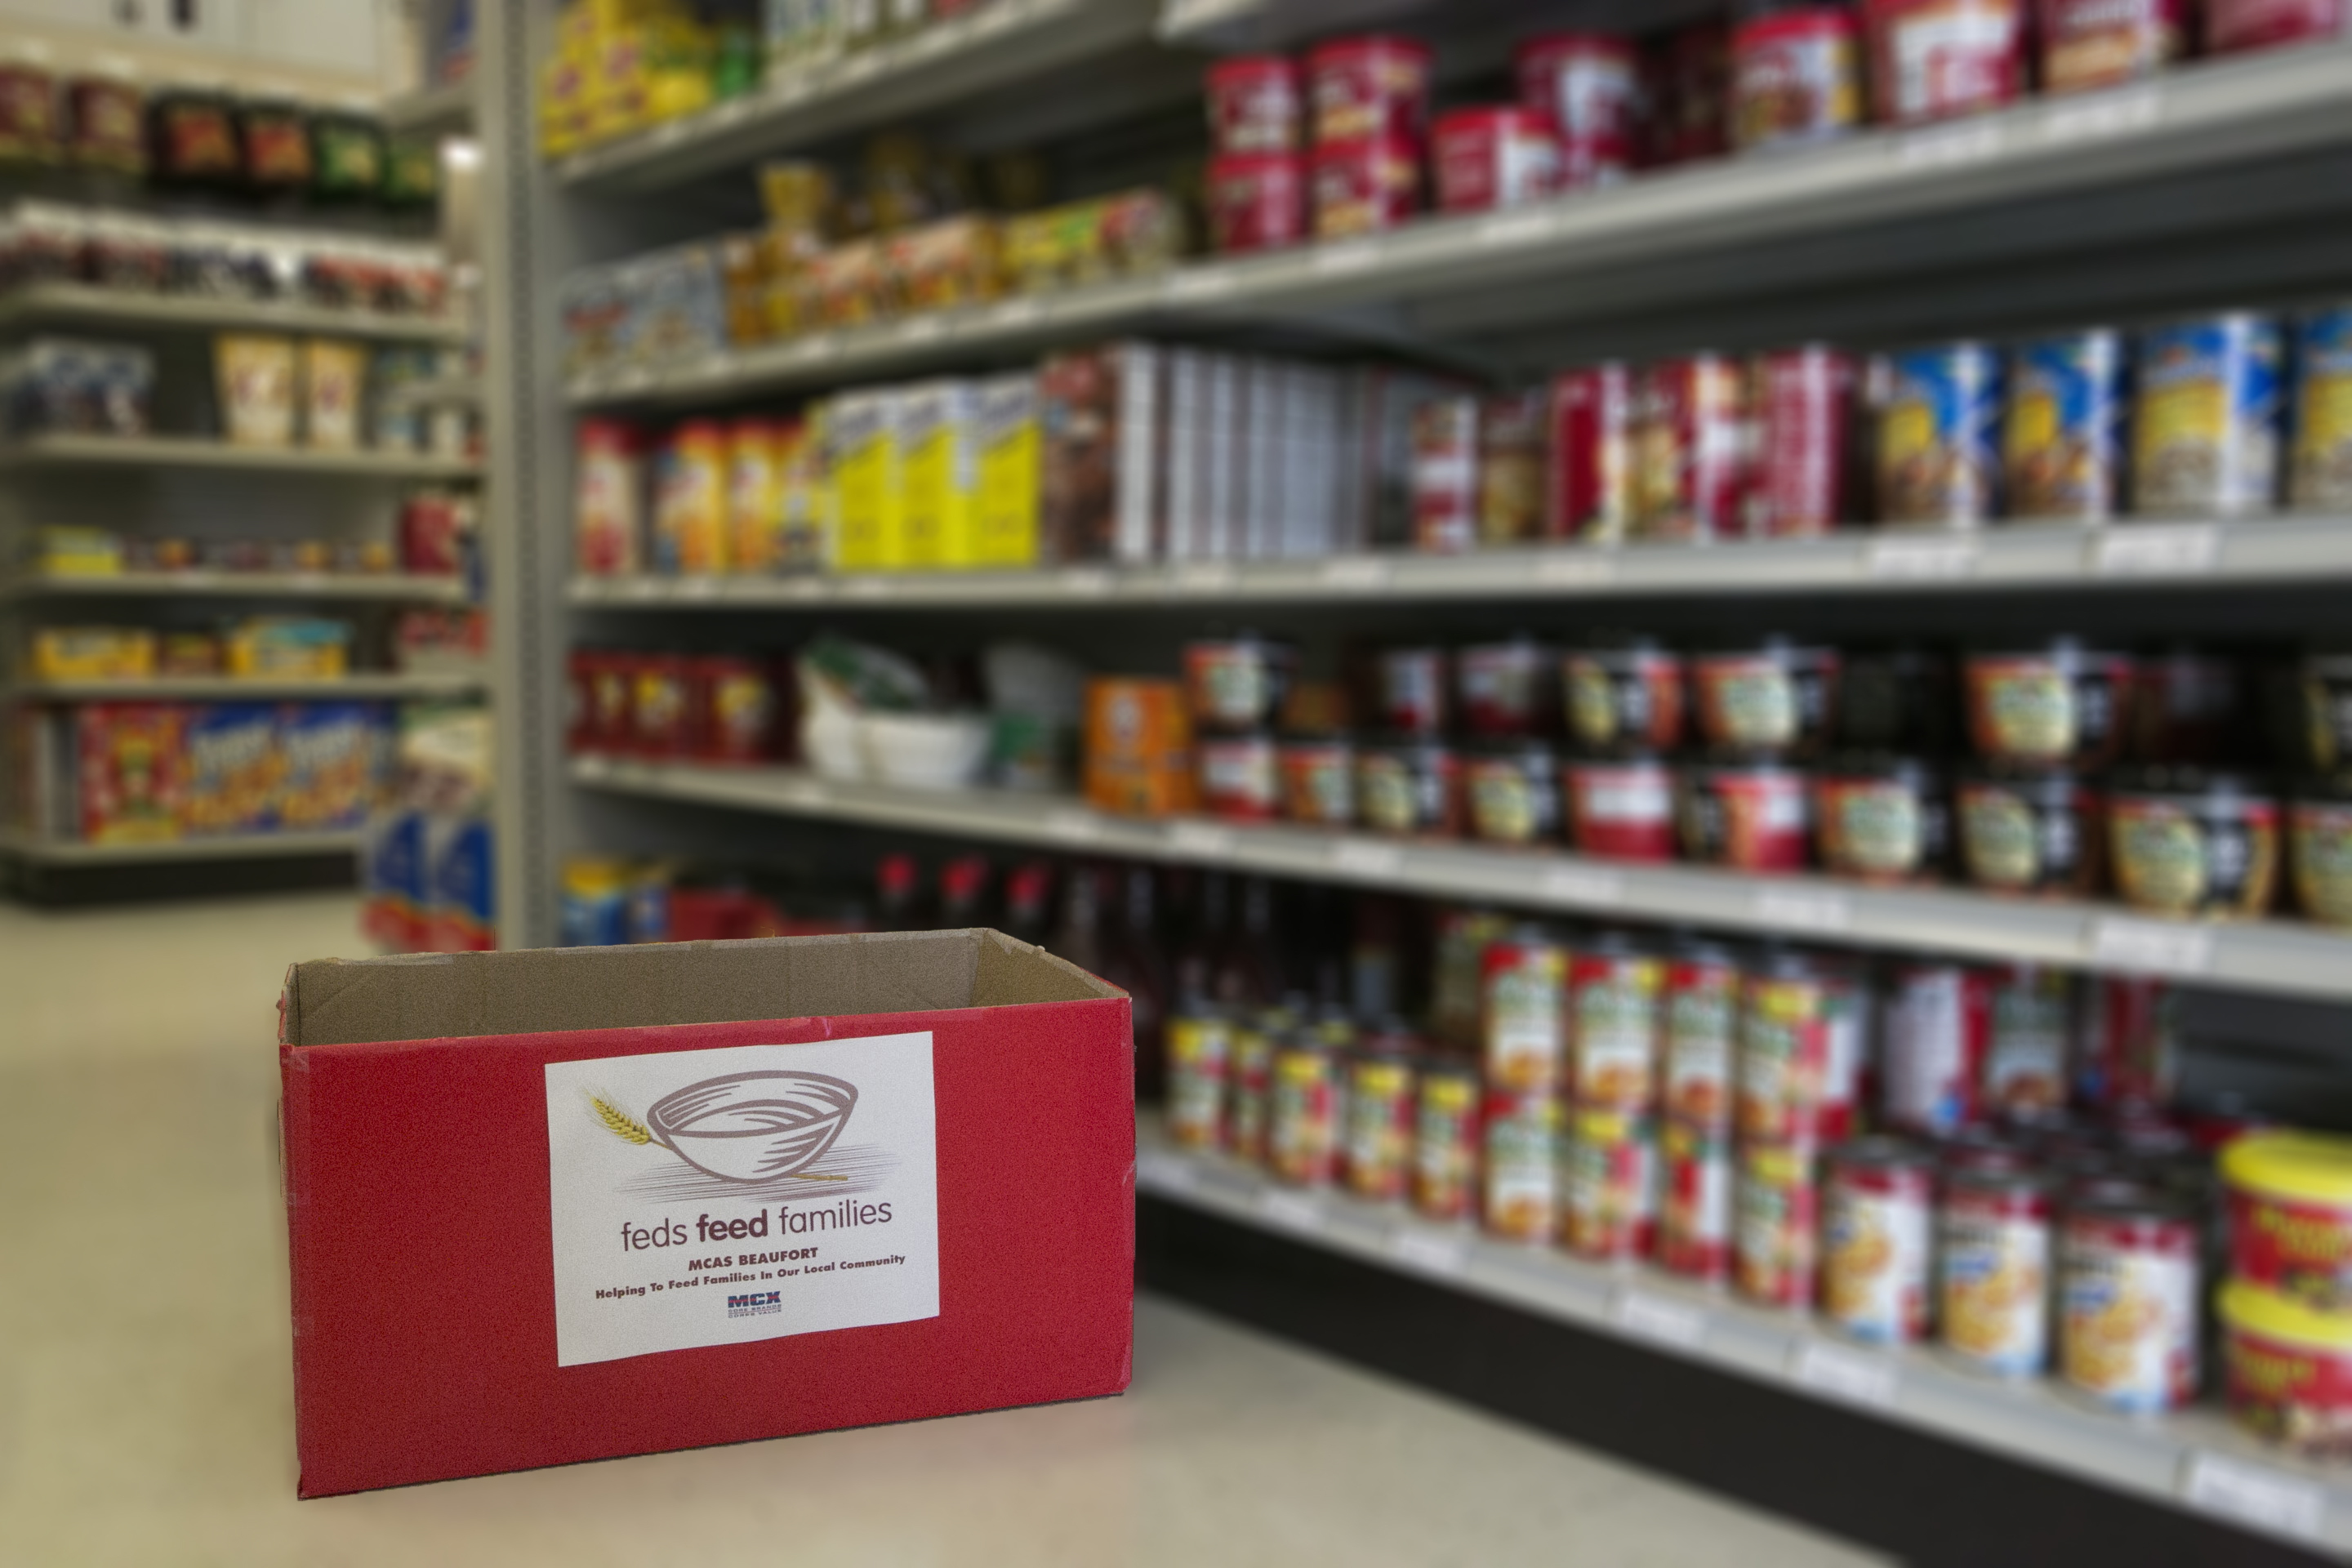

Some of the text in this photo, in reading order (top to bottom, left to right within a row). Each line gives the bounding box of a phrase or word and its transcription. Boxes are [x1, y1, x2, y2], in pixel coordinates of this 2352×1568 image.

[621, 1199, 892, 1251] feds feed families
[595, 1254, 906, 1298] Helping To Feed Families In Our Local Community
[688, 1247, 818, 1271] MCAS BEAUFORT
[728, 1290, 781, 1308] MCX
